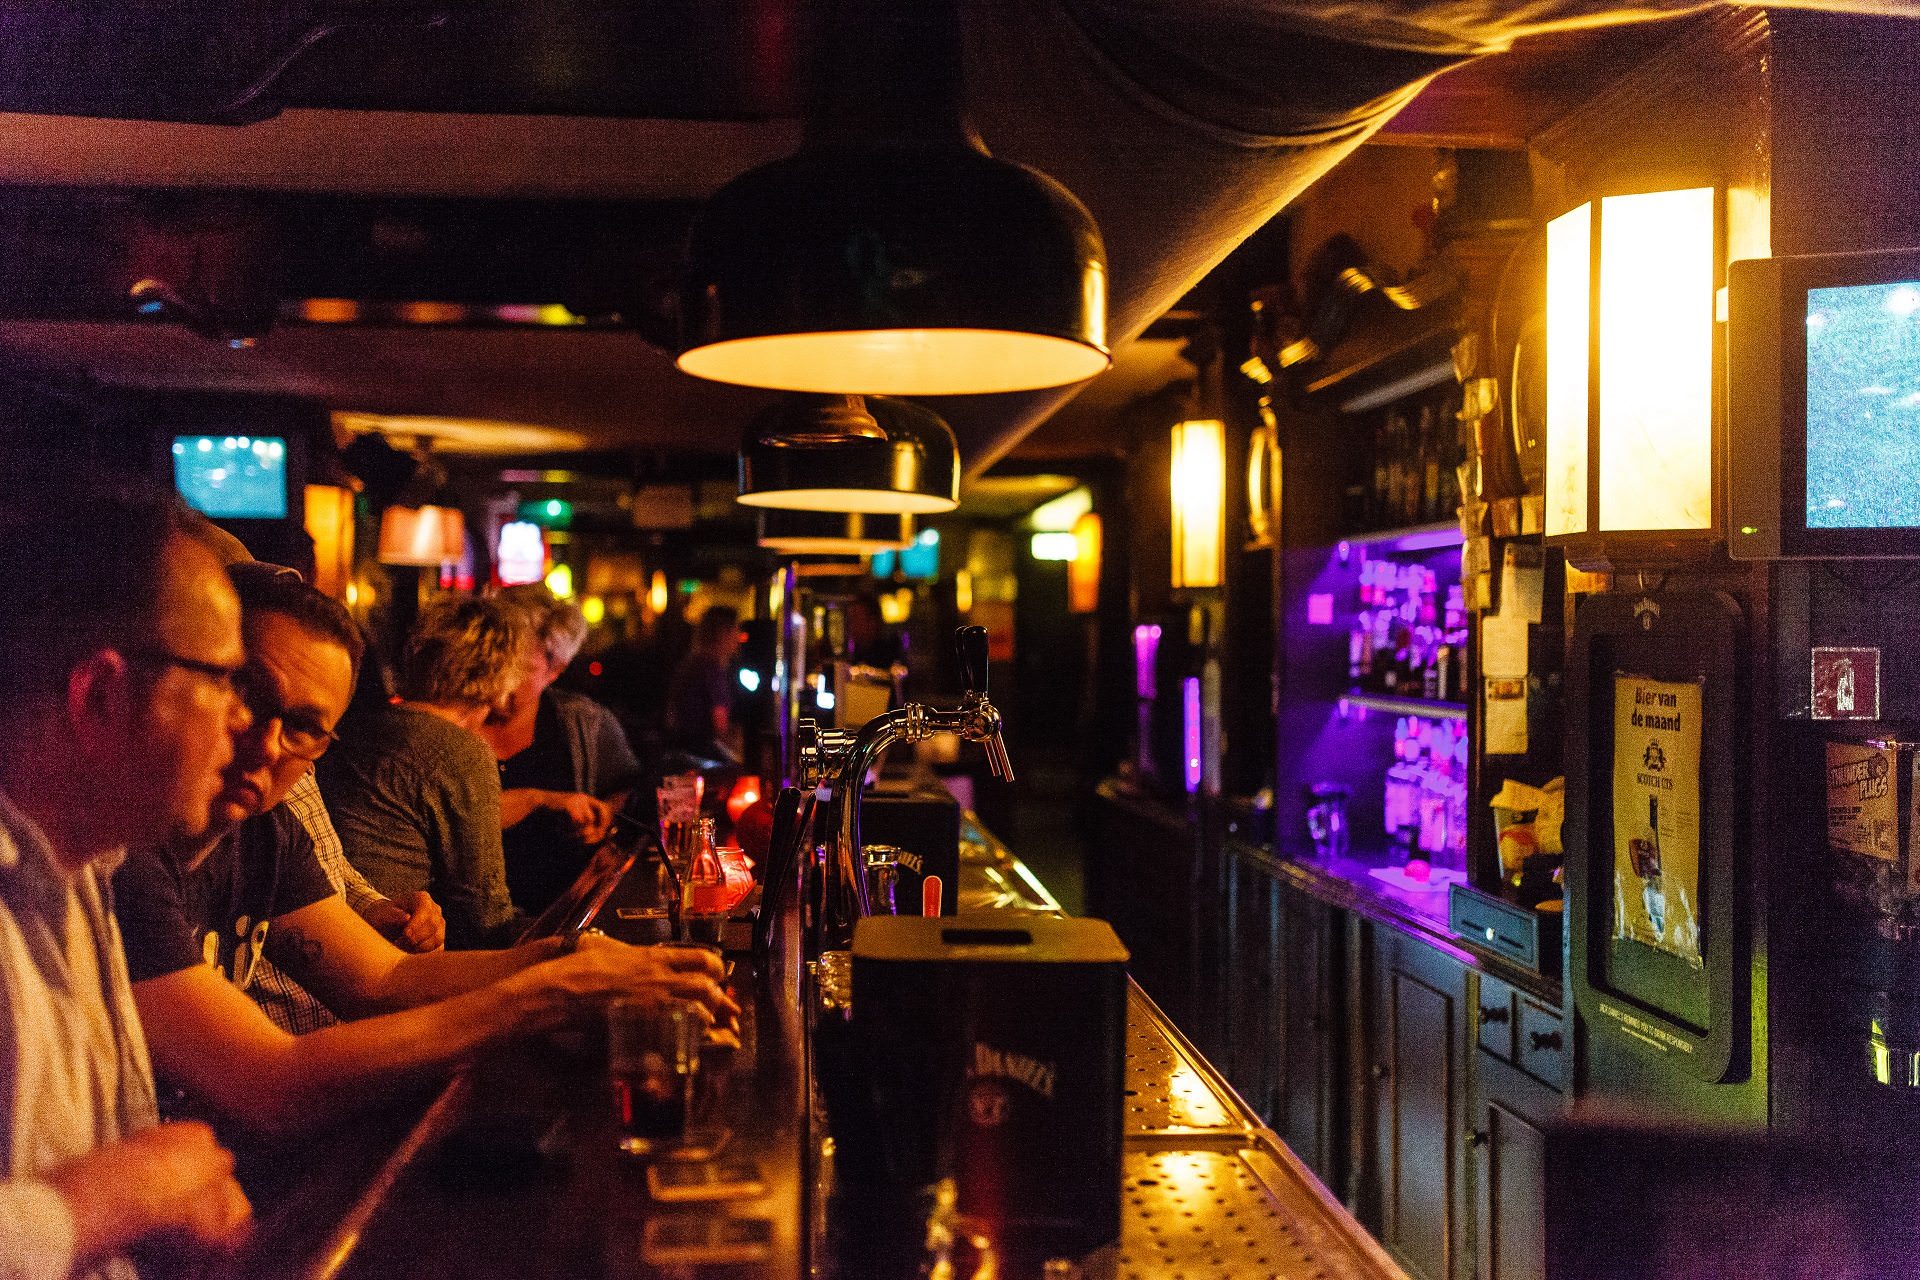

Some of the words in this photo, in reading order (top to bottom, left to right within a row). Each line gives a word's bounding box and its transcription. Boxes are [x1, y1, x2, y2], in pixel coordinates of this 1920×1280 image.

[1635, 686, 1657, 705] Bier
[1658, 693, 1677, 708] van
[1631, 708, 1644, 727] de
[1645, 712, 1681, 732] maand
[1859, 774, 1888, 801] PLUGS
